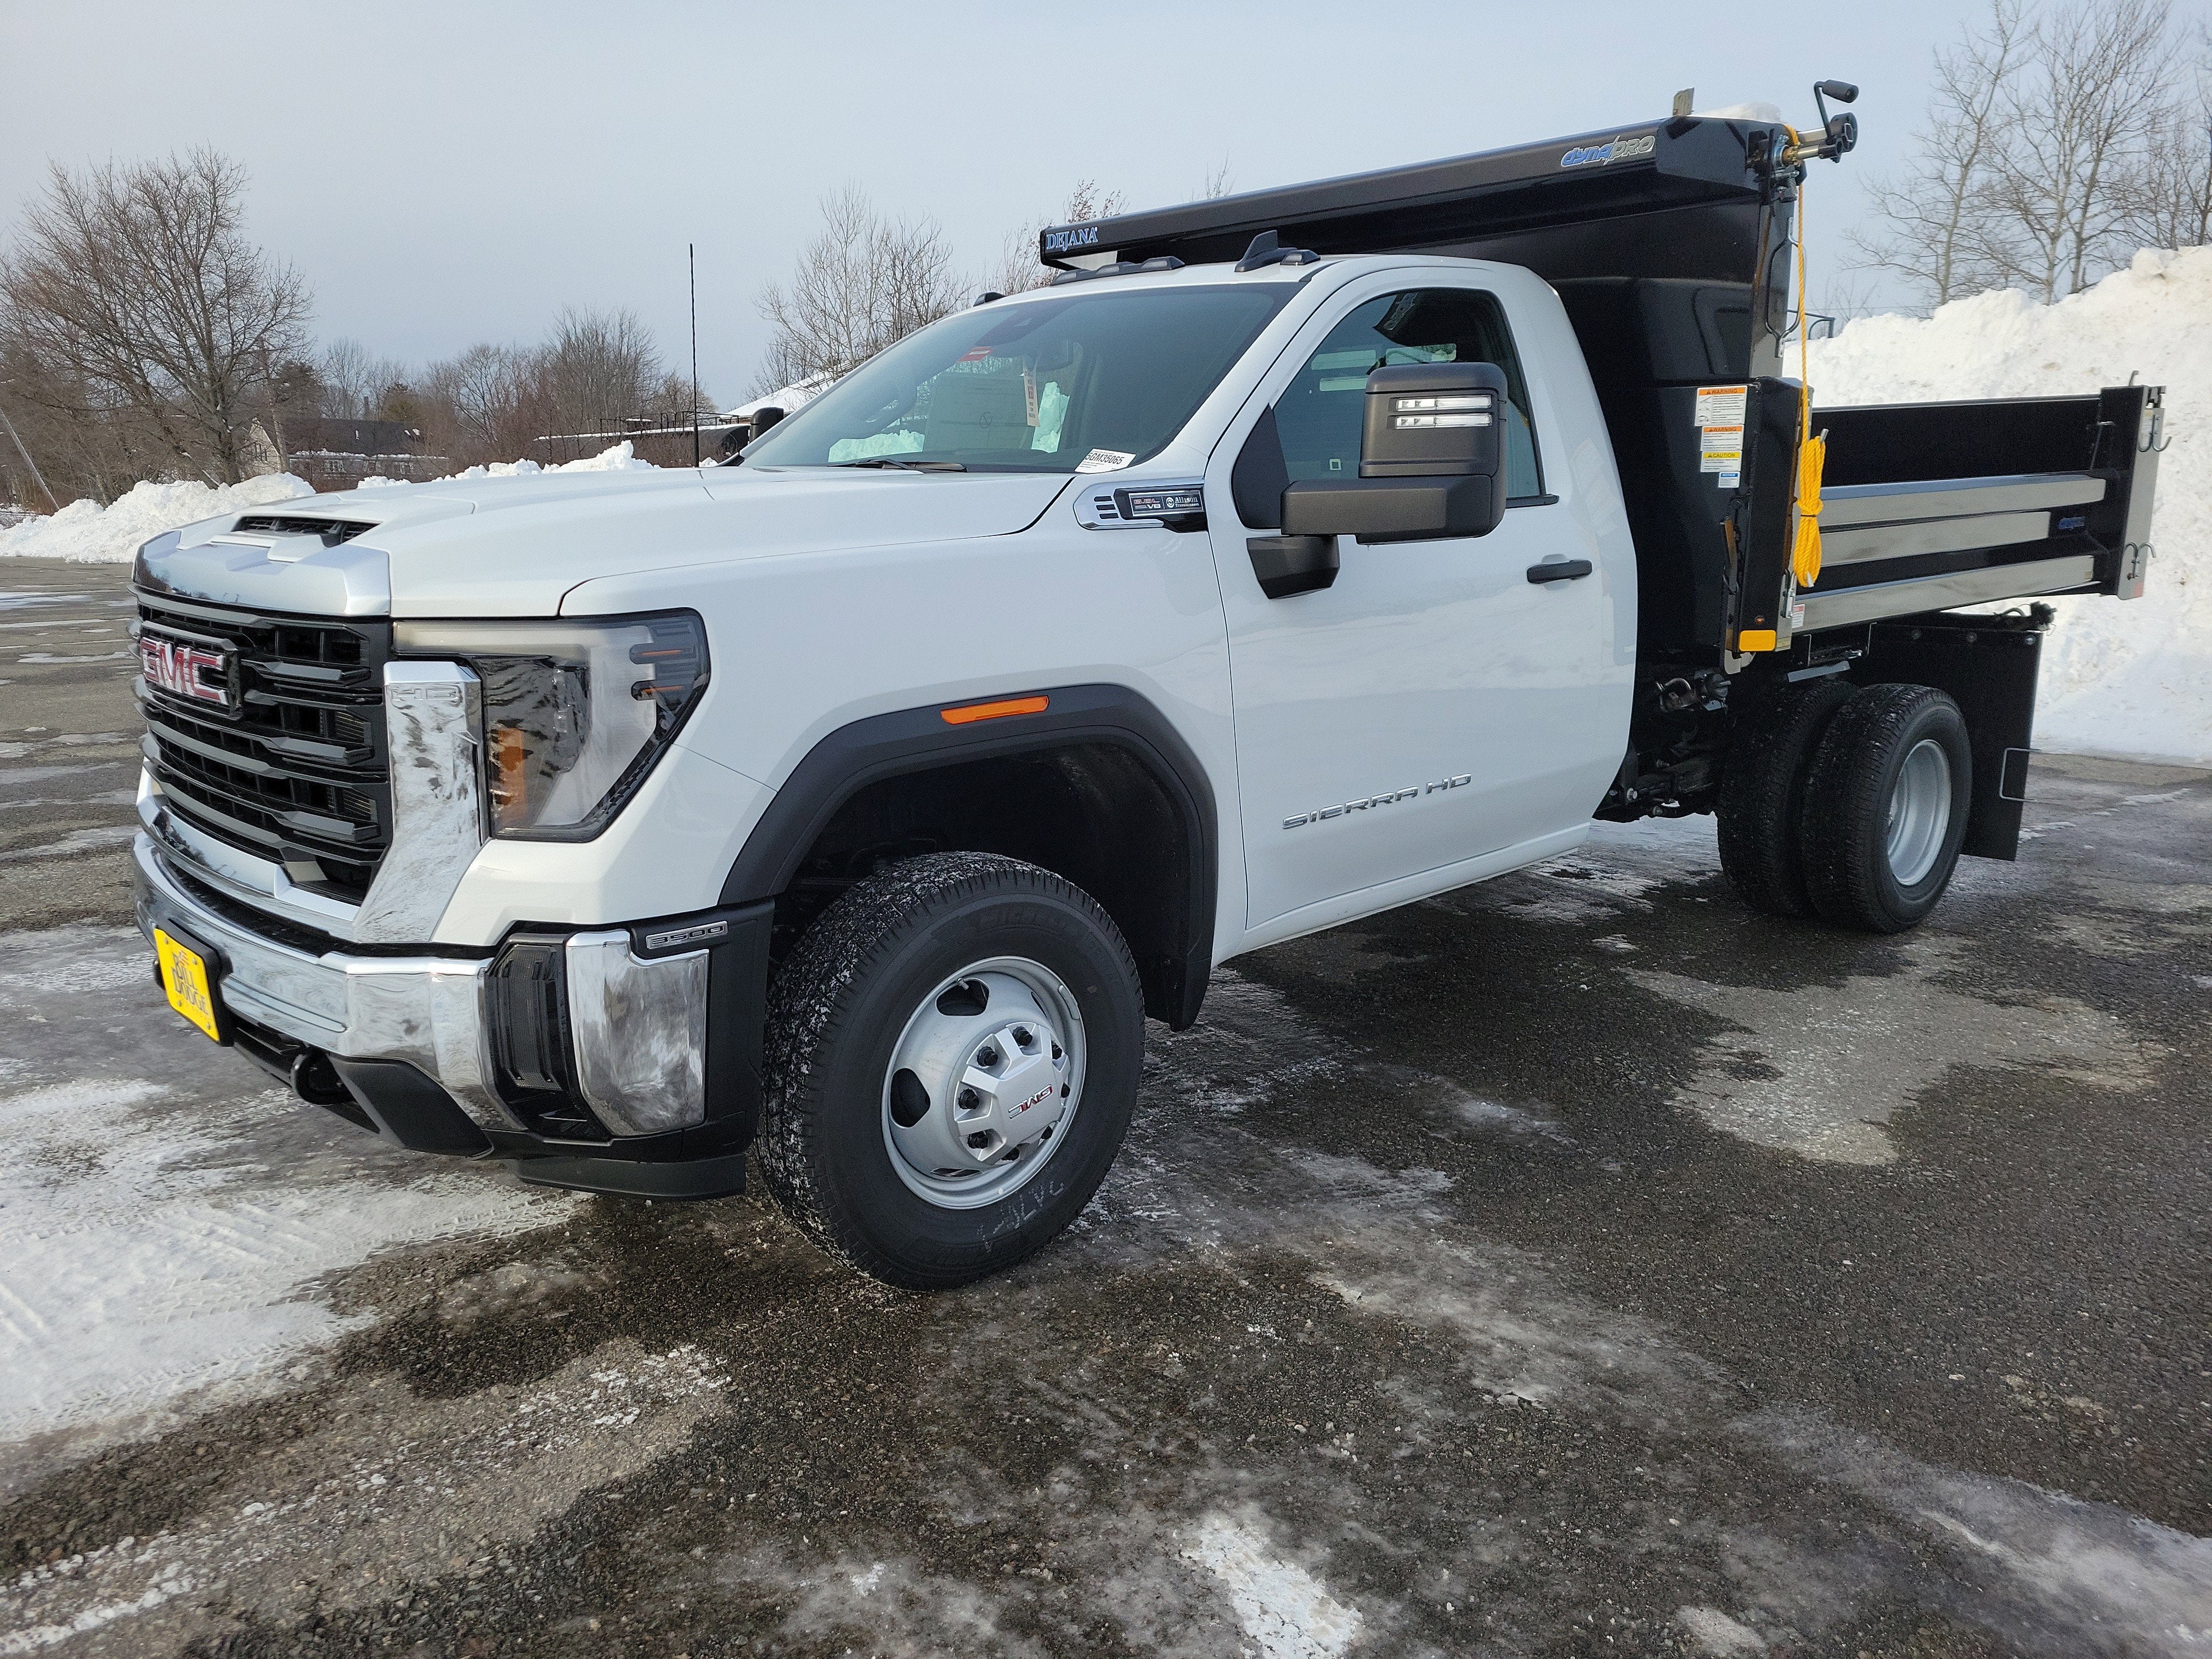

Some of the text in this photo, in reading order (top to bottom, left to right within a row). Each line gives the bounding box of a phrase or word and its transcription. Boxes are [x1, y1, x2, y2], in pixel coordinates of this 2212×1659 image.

[1046, 227, 1098, 251] DEJANA
[1085, 453, 1125, 465] 5GM35065
[140, 636, 229, 706] GMC
[1283, 772, 1472, 830] SIERRA HD
[651, 926, 724, 945] 3500
[1008, 1084, 1053, 1120] GMC
